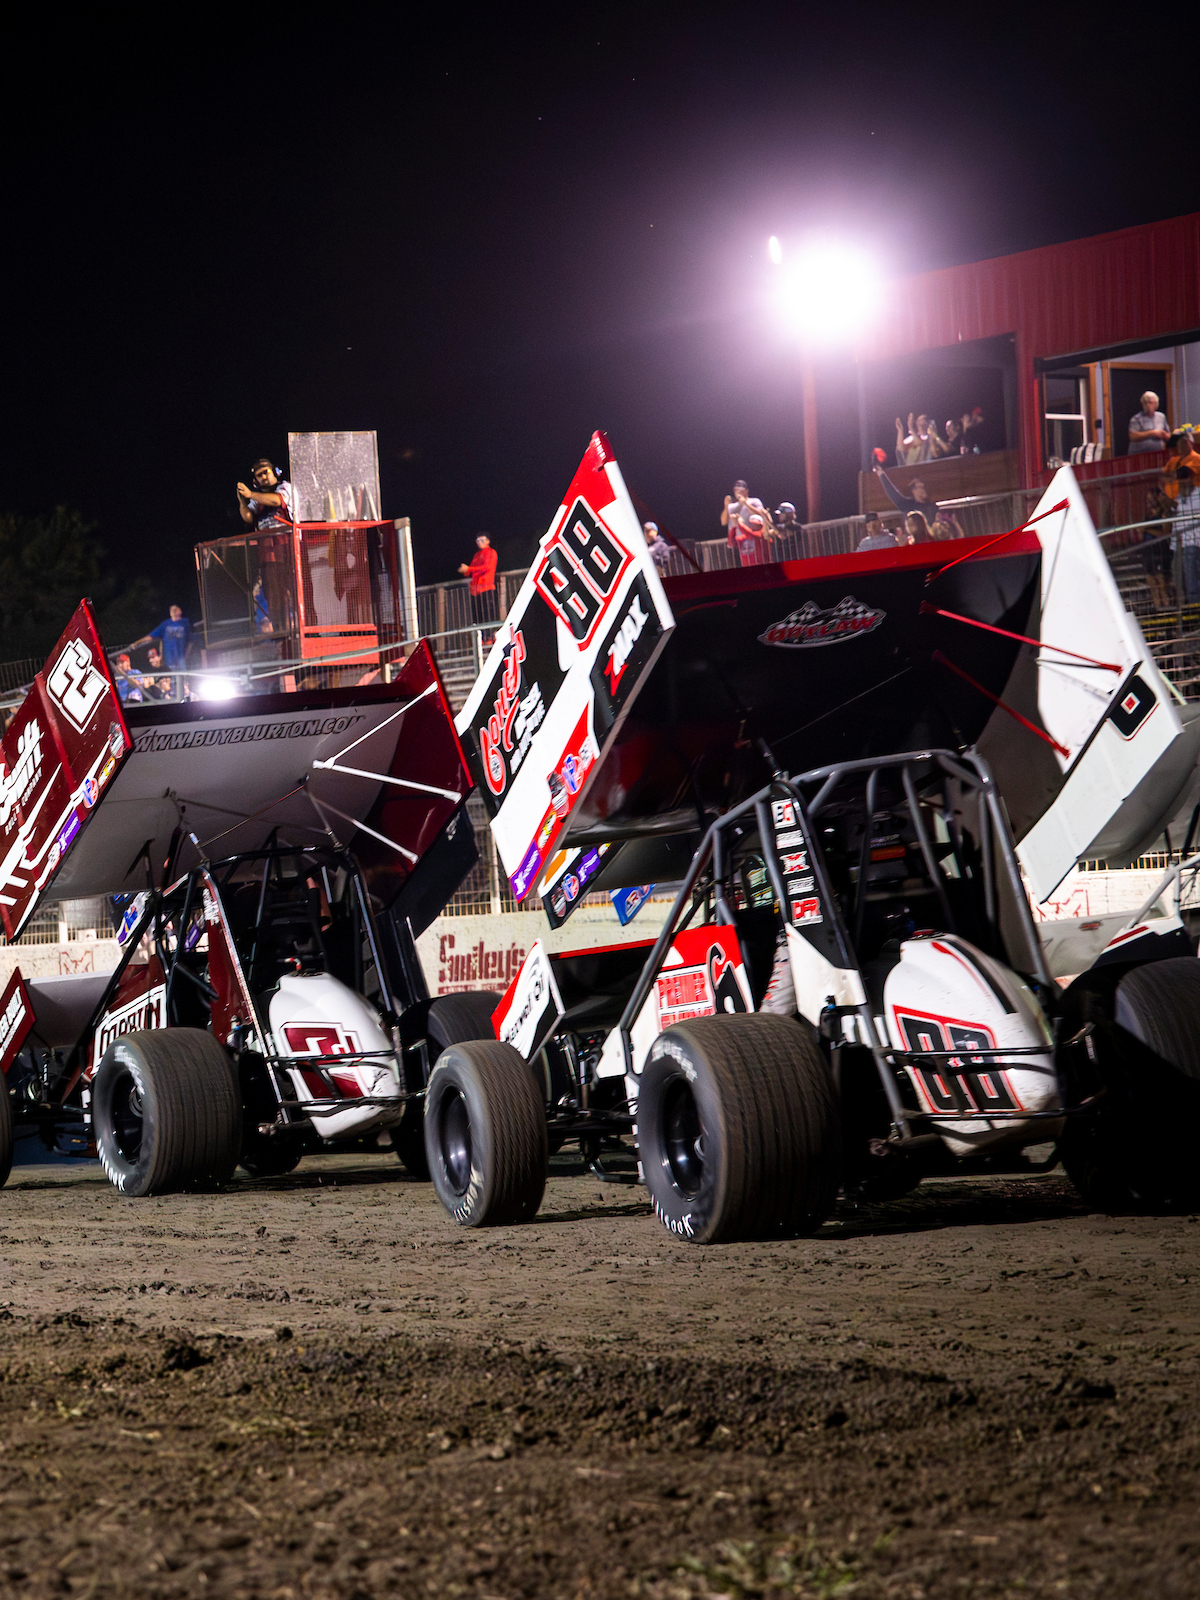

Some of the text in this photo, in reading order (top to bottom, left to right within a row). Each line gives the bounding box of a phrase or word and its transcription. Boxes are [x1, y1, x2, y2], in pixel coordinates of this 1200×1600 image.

[535, 496, 634, 650] 88
[438, 934, 525, 986] Smiley's
[896, 1010, 1024, 1113] 88
